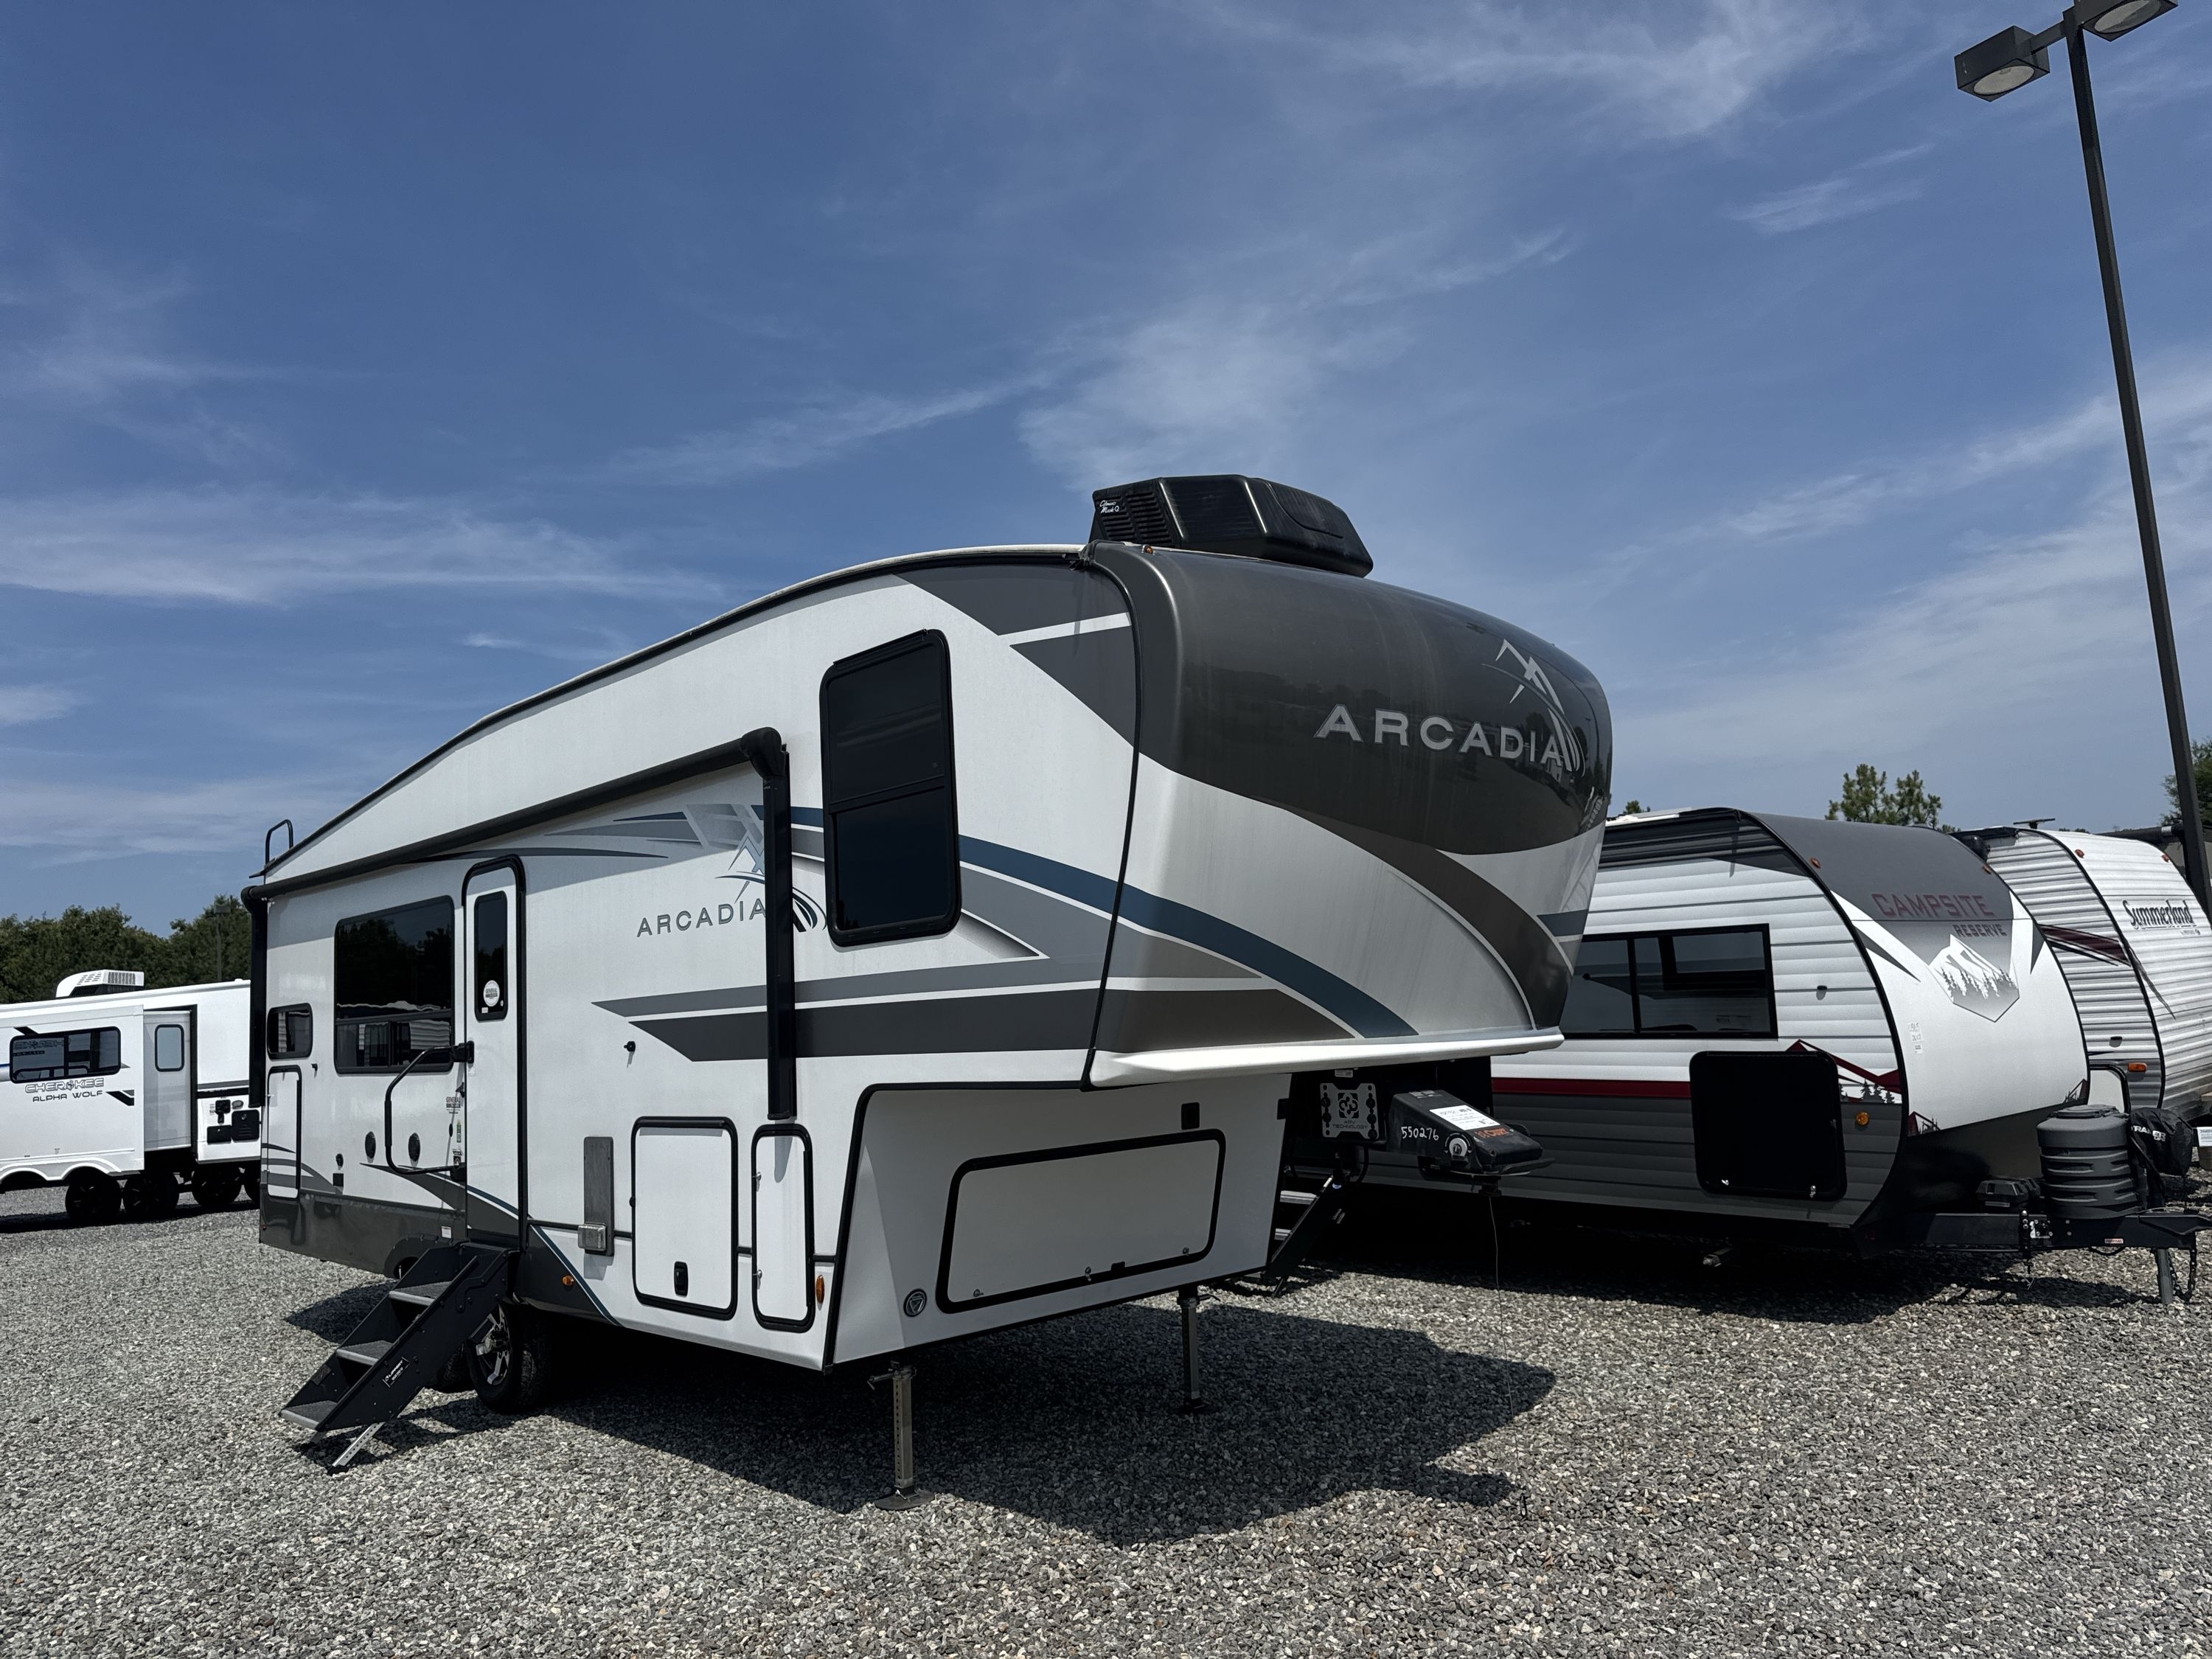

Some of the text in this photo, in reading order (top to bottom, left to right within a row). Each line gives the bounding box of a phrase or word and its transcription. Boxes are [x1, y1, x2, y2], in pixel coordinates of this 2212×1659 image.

[1313, 703, 1568, 770] ARCADIA
[636, 898, 766, 937] ARCADIA
[1871, 894, 1994, 918] CAMPSITE
[2123, 900, 2194, 926] Summerland
[1952, 924, 2007, 937] RESERVE
[32, 1091, 102, 1102] ALPHA WOLF
[1401, 1126, 1439, 1141] 550276
